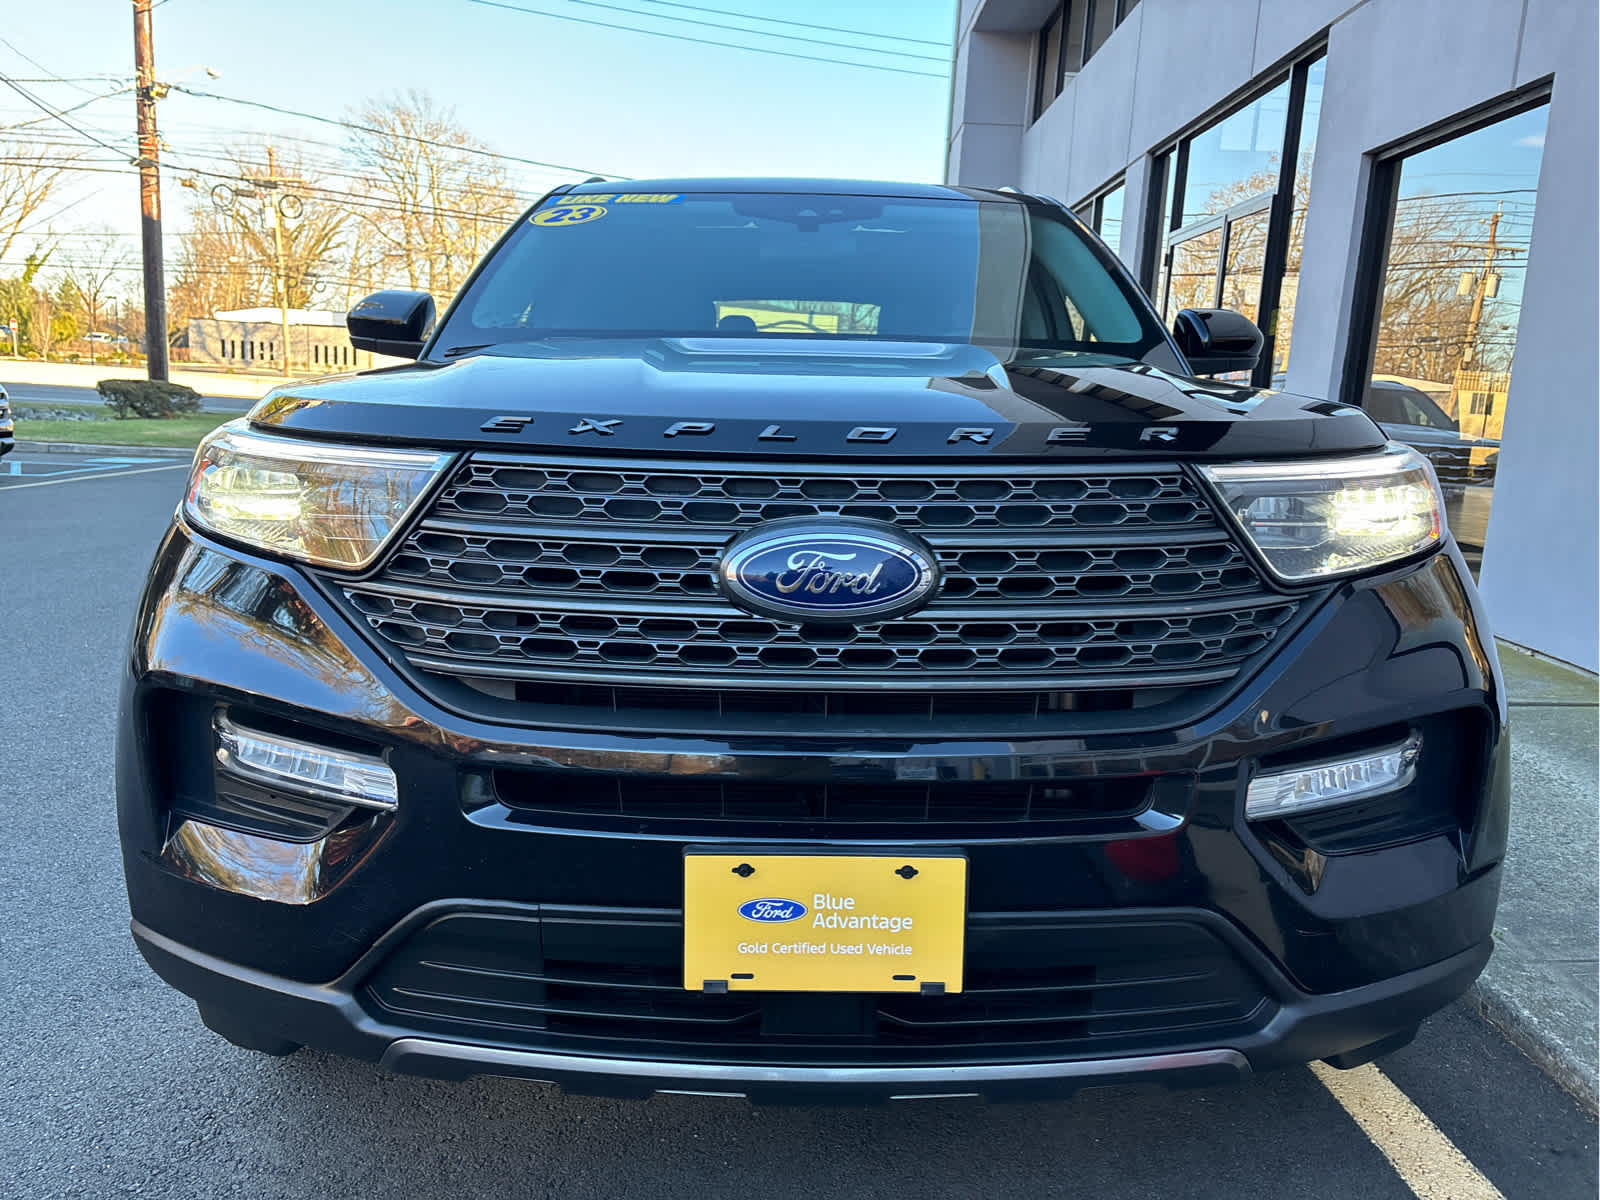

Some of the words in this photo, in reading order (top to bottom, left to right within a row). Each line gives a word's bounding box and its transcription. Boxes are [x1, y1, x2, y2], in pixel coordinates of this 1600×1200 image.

[614, 193, 678, 203] NEW
[543, 207, 596, 223] 23
[480, 416, 1179, 444] EXPLORER
[776, 550, 883, 595] Ford
[751, 901, 793, 919] Ford
[813, 894, 855, 910] Blue
[812, 913, 913, 933] Advantage
[737, 942, 768, 954] Gold
[771, 942, 826, 955] Certified
[830, 943, 863, 955] Used
[866, 943, 913, 956] Vehicle
